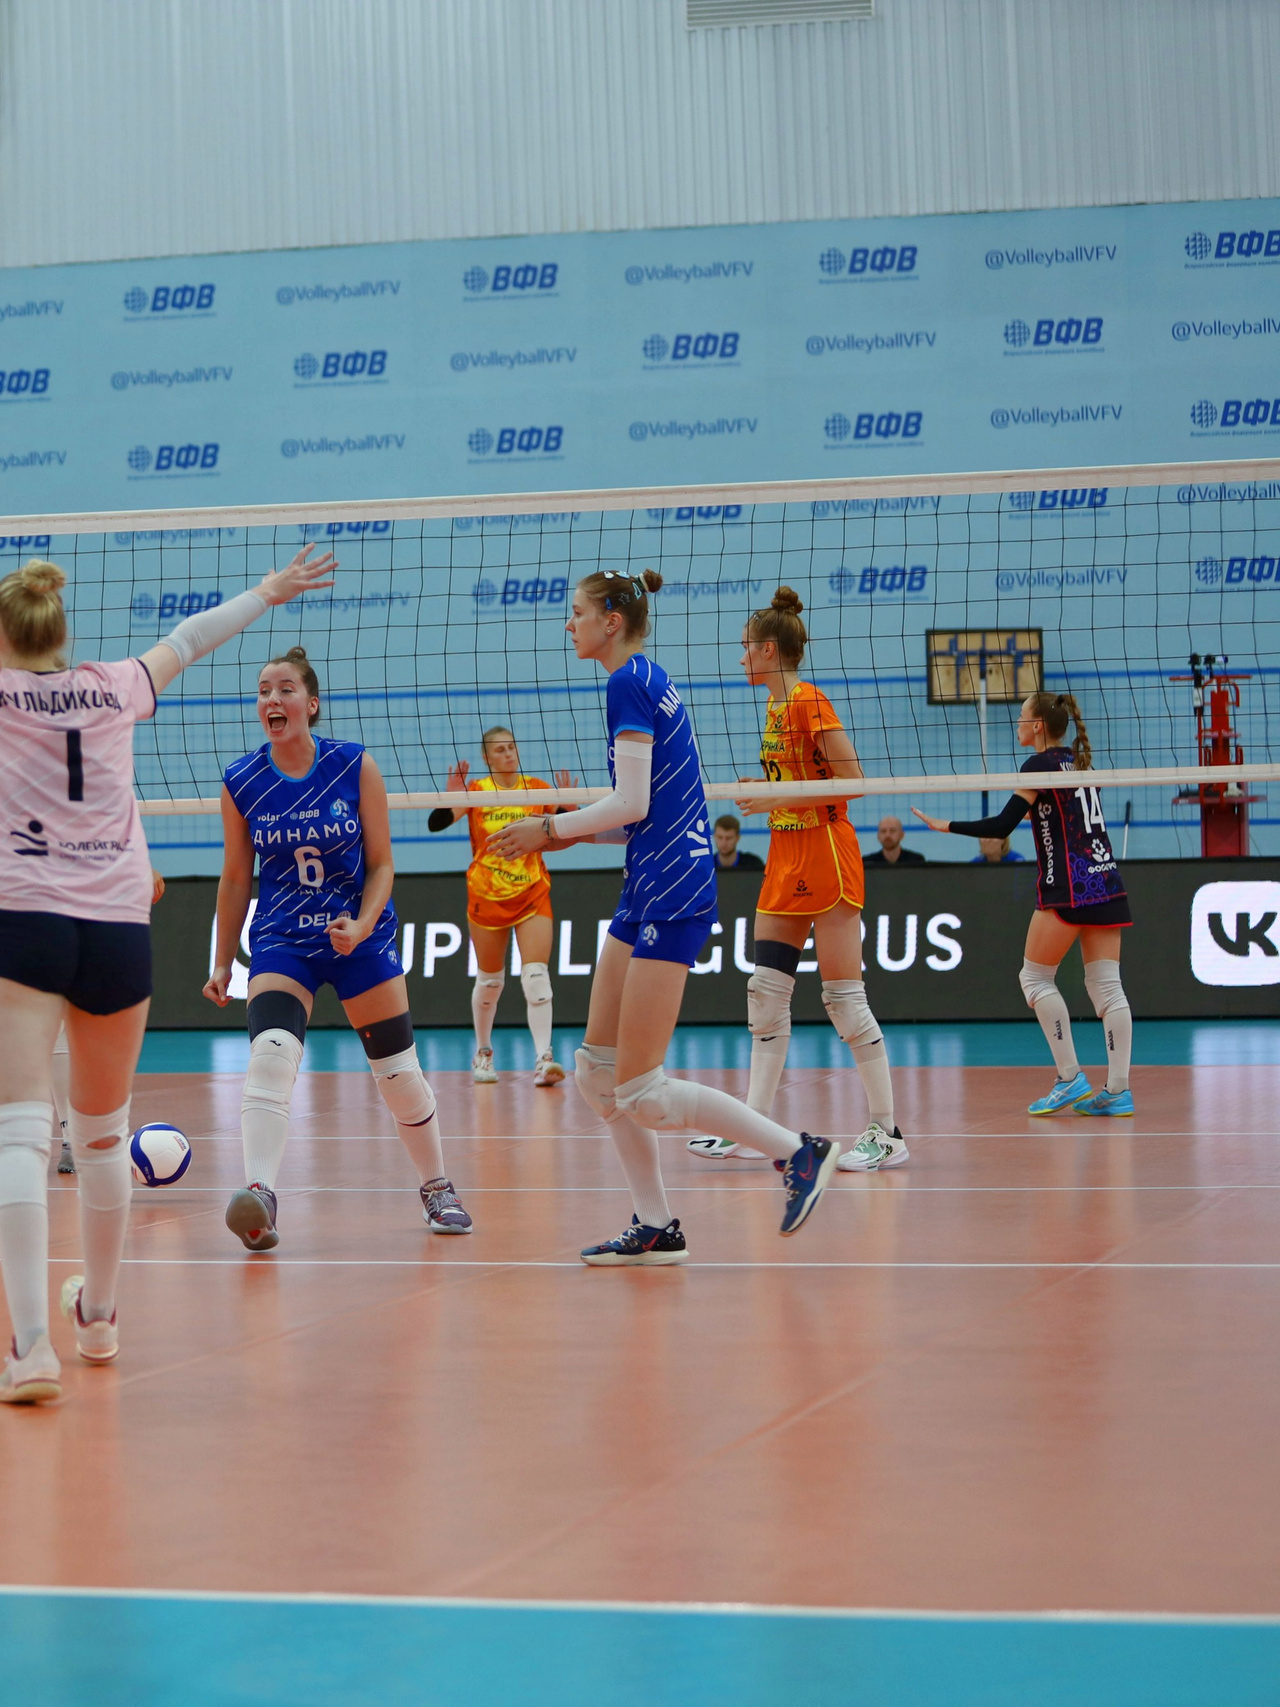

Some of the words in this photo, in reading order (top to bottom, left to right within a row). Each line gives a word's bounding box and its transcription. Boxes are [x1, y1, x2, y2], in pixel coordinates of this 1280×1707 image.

[848, 246, 917, 274] ВФВ
[985, 245, 1116, 270] @VolleyballVFV
[491, 263, 558, 292] ВФВ
[624, 261, 754, 286] @VolleyballVFV
[151, 284, 215, 312] ВФВ
[275, 280, 401, 306] @VolleyballVFV
[671, 332, 740, 360] ВФВ
[805, 331, 936, 356] @VolleyballVFV
[1033, 318, 1103, 346] ВФВ
[321, 350, 387, 378] ВФВ
[450, 347, 577, 371] @VolleyballVFV
[110, 366, 233, 391] @VolleyballVFV
[629, 417, 758, 442] @VolleyballVFV
[853, 411, 923, 440] ВФВ
[990, 404, 1122, 429] @VolleyballVFV
[280, 433, 406, 458] @VolleyballVFV
[496, 426, 563, 454] ВФВ
[155, 443, 219, 471] ВФВ
[858, 565, 927, 593] ВФВ
[995, 567, 1127, 592] @VolleyballVFV
[1225, 555, 1280, 583] ВФ
[500, 577, 567, 605] ВФВ
[66, 729, 84, 801] 1
[1075, 787, 1106, 834] 14
[253, 819, 357, 848] ДИНАМО
[293, 845, 325, 888] 6
[1040, 820, 1055, 885] PHOSAGRO
